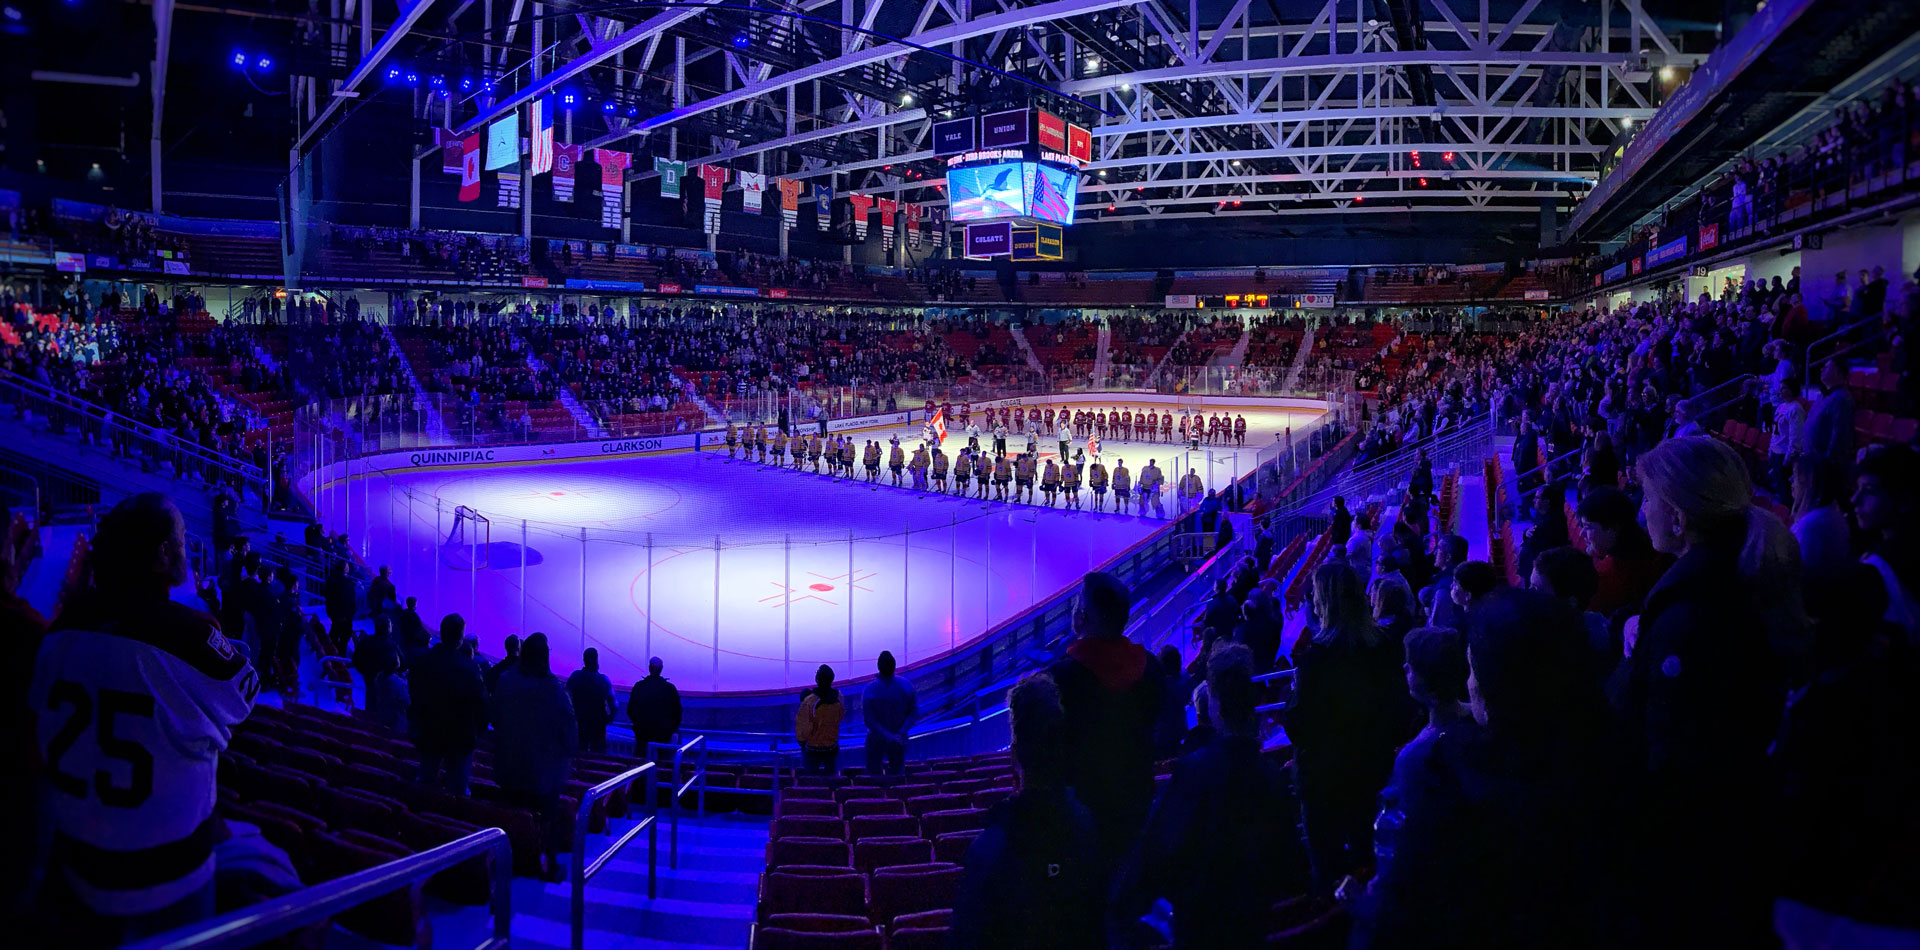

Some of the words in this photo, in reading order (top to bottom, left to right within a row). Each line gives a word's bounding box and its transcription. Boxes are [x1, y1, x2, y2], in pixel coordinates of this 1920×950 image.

[994, 124, 1015, 134] UNION
[945, 133, 962, 142] YALE
[666, 169, 676, 184] D
[711, 177, 718, 187] H
[975, 235, 1004, 243] COLGATE
[1697, 266, 1706, 276] 19
[1316, 296, 1332, 304] NY
[601, 439, 662, 453] CLARKSON
[410, 450, 495, 466] QUINNIPIAC
[48, 679, 154, 808] 25
